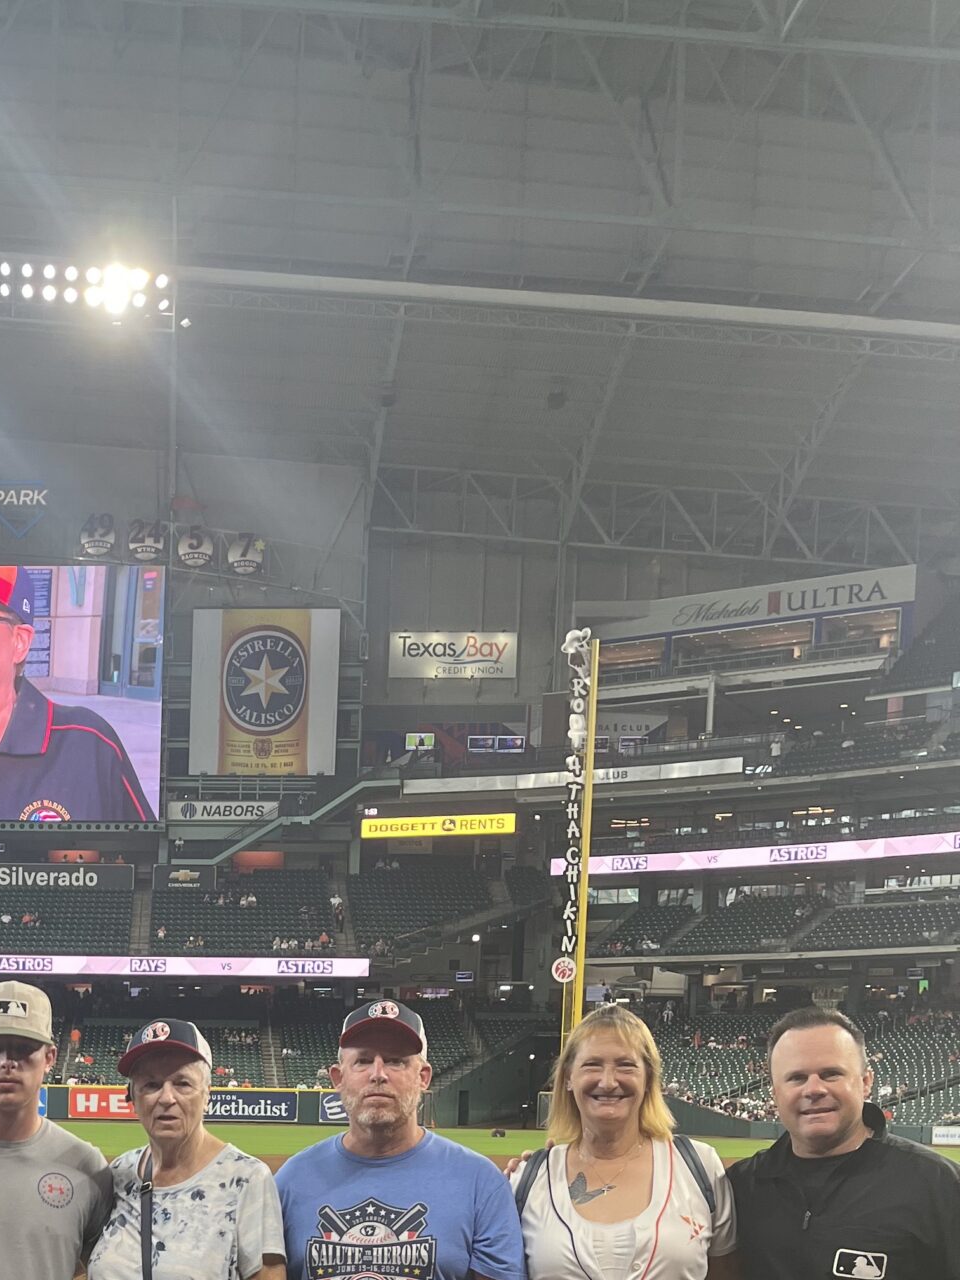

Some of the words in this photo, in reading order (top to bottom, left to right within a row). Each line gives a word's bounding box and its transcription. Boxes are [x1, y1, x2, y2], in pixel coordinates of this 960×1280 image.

[129, 518, 162, 544] 24
[188, 525, 203, 550] 5
[238, 532, 256, 558] 7
[672, 598, 763, 627] Michelob
[787, 580, 888, 612] ULTRA
[232, 638, 300, 668] ESTRELLA
[398, 636, 457, 658] Texas
[466, 636, 509, 665] Bay
[435, 666, 467, 675] CREDIT
[470, 666, 504, 675] UNION
[235, 703, 294, 725] JALISCO
[621, 724, 651, 732] CLUB
[201, 805, 265, 817] NABORS
[368, 822, 438, 833] DOGGETT
[460, 818, 505, 831] RENTS
[613, 856, 647, 871] RAYS
[707, 855, 718, 864] VS
[770, 846, 827, 862] ASTROS
[561, 846, 580, 953] CHIKIN
[0, 957, 53, 971] ASTROS
[131, 959, 166, 973] RAYS
[221, 962, 232, 971] VS
[278, 960, 333, 974] ASTROS
[76, 1094, 132, 1114] H-E
[203, 1099, 289, 1117] Methodist
[311, 1243, 363, 1267] SALUTE
[372, 1243, 429, 1267] HEROES
[336, 1265, 356, 1274] JUNE
